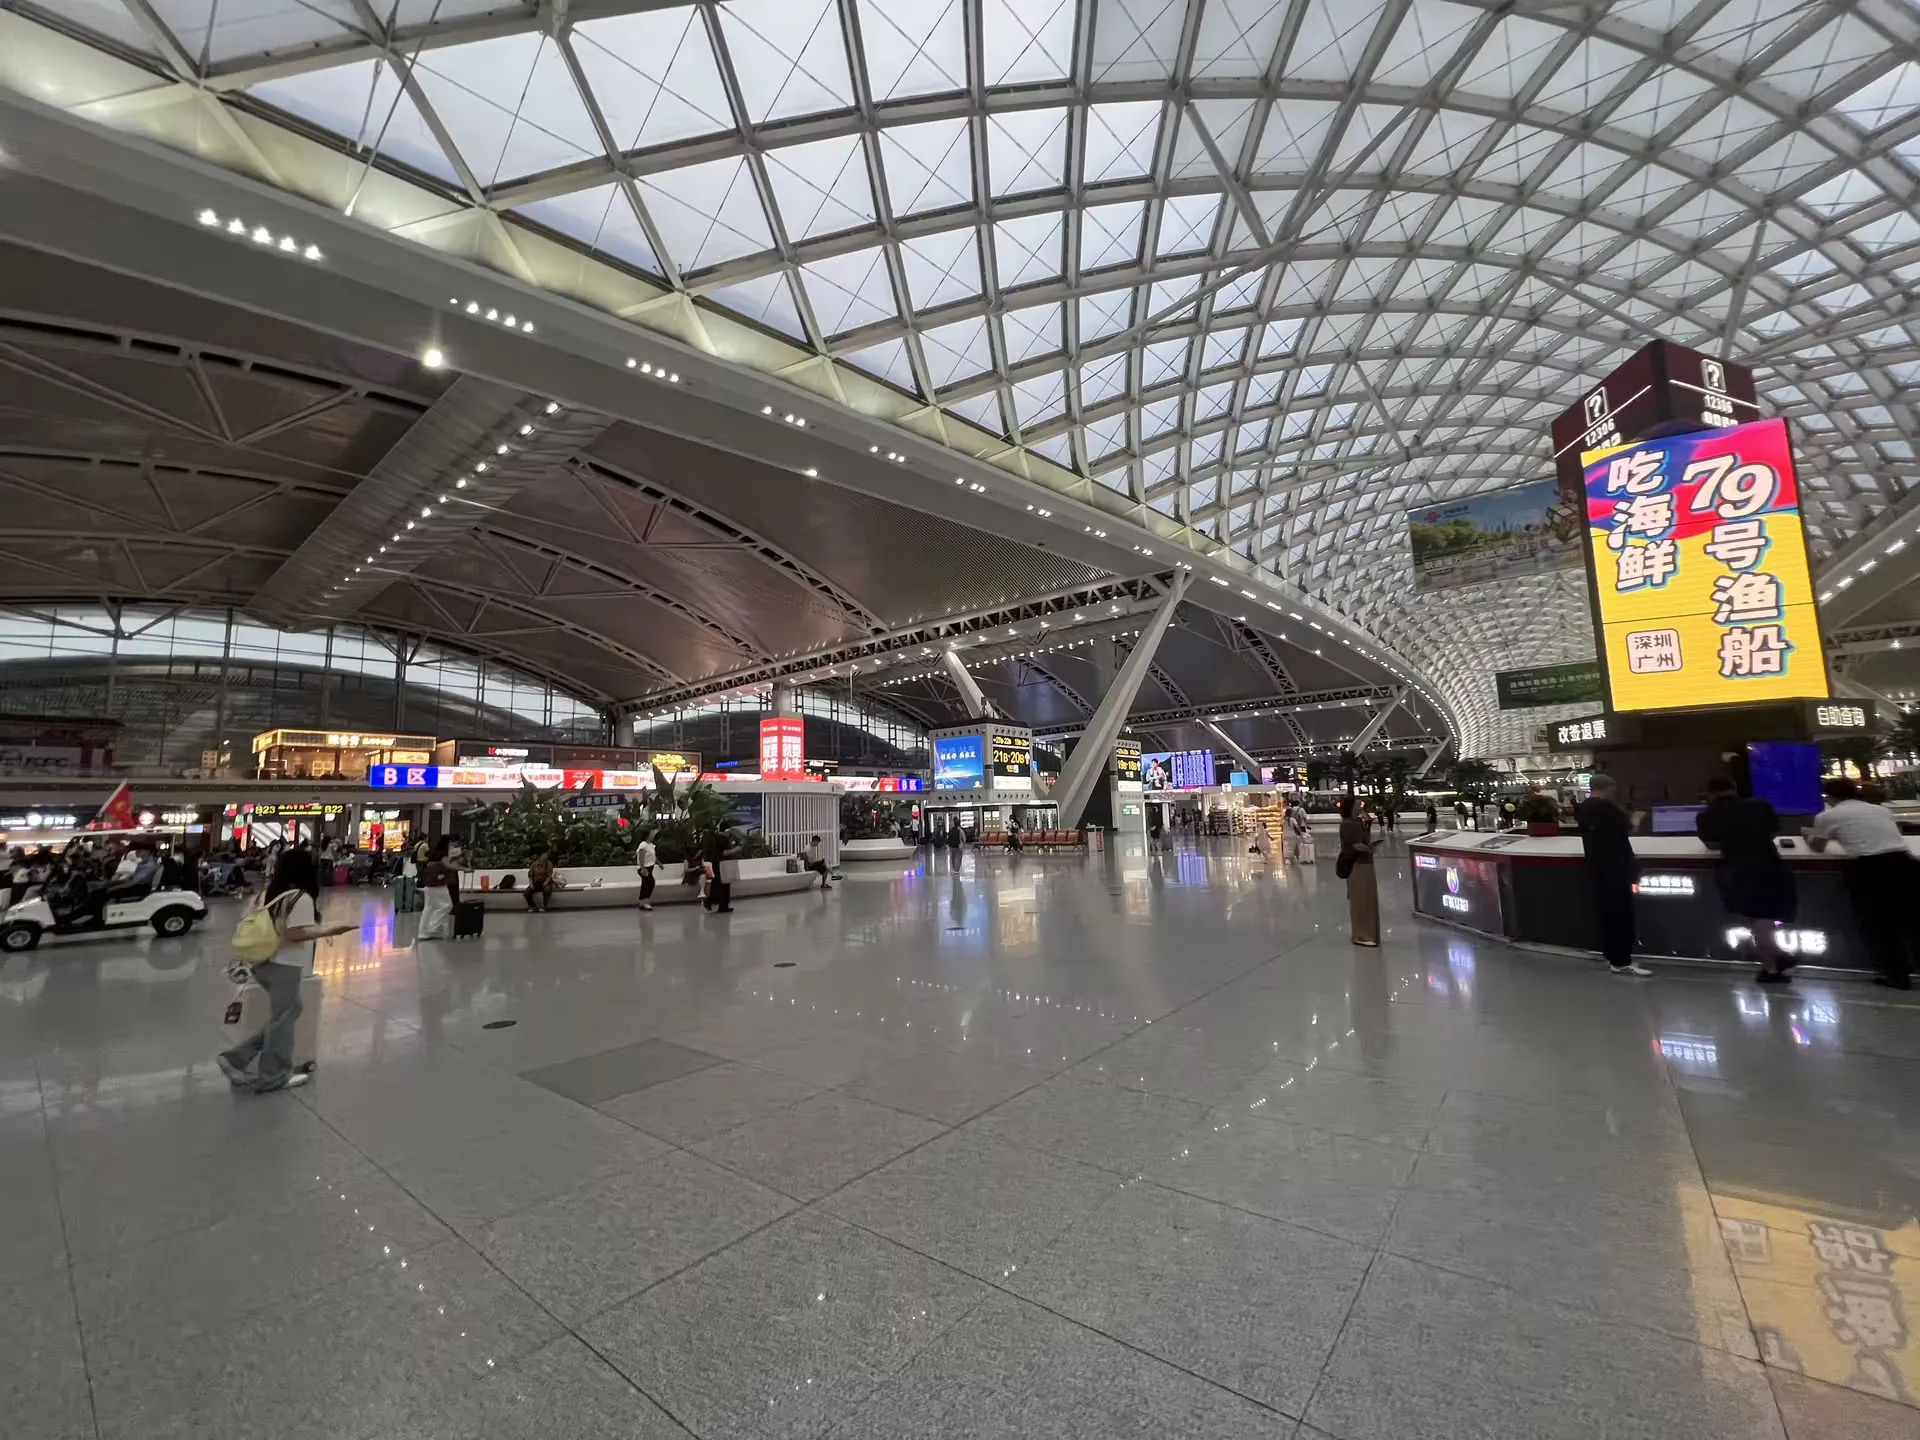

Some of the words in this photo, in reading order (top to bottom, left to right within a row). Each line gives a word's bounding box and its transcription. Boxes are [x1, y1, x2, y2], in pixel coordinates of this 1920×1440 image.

[1704, 394, 1734, 414] 12306
[1585, 418, 1616, 447] 12306
[1607, 450, 1678, 591] 吃海鲜
[1681, 453, 1792, 677] 79号渔船
[1634, 633, 1673, 650] 深圳
[1637, 653, 1676, 669] 广州
[1817, 706, 1865, 727] 自助查询
[1558, 720, 1606, 743] 改签退票
